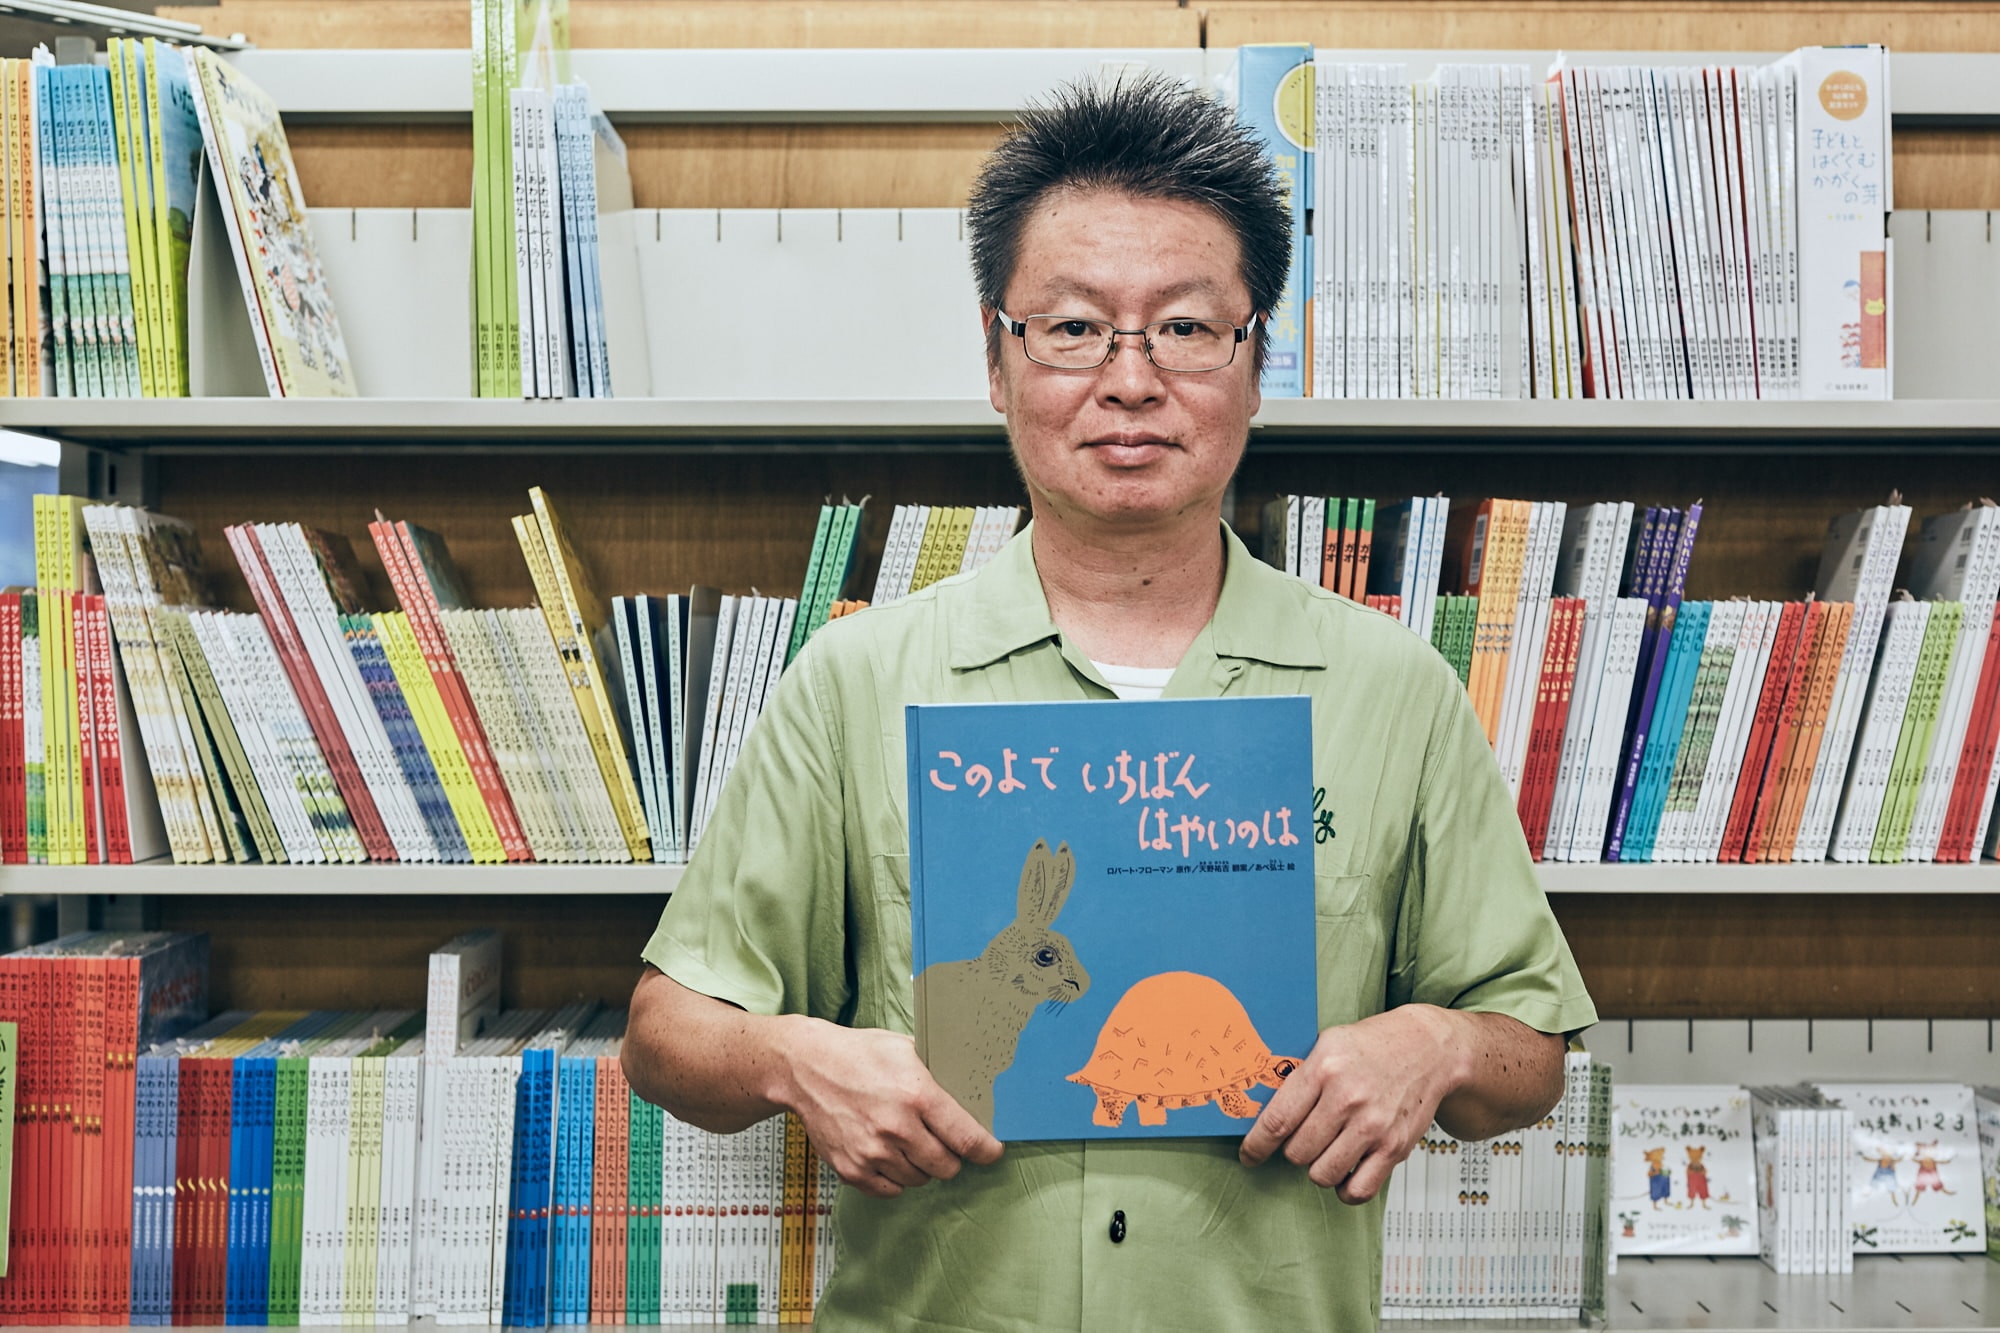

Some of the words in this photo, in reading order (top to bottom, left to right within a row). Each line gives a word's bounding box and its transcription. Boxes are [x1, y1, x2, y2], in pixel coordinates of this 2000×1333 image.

[1812, 129, 1864, 149] 子どもと
[1812, 152, 1875, 169] はぐくむ
[514, 162, 524, 217] しあわせな
[540, 163, 550, 218] しあわせな
[36, 510, 45, 580] サラダでげんき
[49, 510, 57, 580] サラダでげんき
[62, 511, 71, 580] サラダでげんき
[1406, 515, 1420, 578] おふろやさん
[1419, 516, 1434, 579] おふろやさん
[1431, 516, 1446, 579] おふろやさん
[1540, 517, 1560, 602] おなかのすくさんぽ
[1603, 518, 1629, 619] おっきょちゃんとかっぱ
[1632, 522, 1653, 593] おしいれじいさん
[1643, 522, 1666, 594] おしいれじいさん
[1654, 523, 1677, 594] おしいれじいさん
[1672, 520, 1697, 595] おしいれじいさん
[1969, 524, 2000, 631] あやちゃんのうまれたひ
[2, 605, 12, 720] サンタさんからきたてがみ
[11, 605, 22, 720] サンタさんからきたてがみ
[73, 609, 86, 679] さかさことばで
[640, 608, 652, 677] くじらのあかちゃん
[670, 608, 678, 676] くじらのあかちゃん
[1605, 612, 1624, 674] おじぞうさん
[1616, 611, 1634, 674] おじぞうさん
[1625, 612, 1644, 674] おじぞうさん
[1671, 611, 1685, 652] おかえし
[1682, 612, 1697, 653] おかえし
[1694, 610, 1709, 651] おかえし
[1773, 614, 1791, 661] エンソくん
[1800, 613, 1816, 661] エンソくん
[88, 611, 102, 679] さかさことばで
[95, 682, 108, 741] うんどうかい
[96, 609, 111, 679] さかさことばで
[104, 682, 118, 741] うんどうかい
[706, 610, 728, 731] くいしんぼうのあおむしくん
[721, 610, 747, 731] くいしんぼうのあおむしくん
[734, 610, 761, 732] くいしんぼうのあおむしくん
[1757, 666, 1777, 724] きしゃにのる
[1784, 666, 1803, 724] きしゃにのる
[1908, 613, 1939, 721] あらいぐまとねずみたち
[1920, 613, 1950, 721] あらいぐまとねずみたち
[1929, 613, 1959, 721] あらいぐまとねずみたち
[78, 681, 91, 741] うんどうかい
[930, 747, 1059, 797] このよで
[1082, 750, 1210, 805] いちばん
[1139, 806, 1299, 858] はやいのは
[1107, 865, 1174, 875] ロバート・フローマン
[129, 973, 137, 1010] おおさむ
[107, 1016, 115, 1044] こさむ
[127, 1016, 135, 1044] こさむ
[146, 1071, 155, 1137] ふわふわふとん
[156, 1071, 165, 1137] ふわふわふとん
[168, 1071, 177, 1137] ふわふわふとん
[201, 1070, 210, 1137] きんいろあらし
[211, 1070, 220, 1137] きんいろあらし
[221, 1070, 231, 1137] きんいろあらし
[309, 1070, 317, 1136] まほうのえのぐ
[340, 1070, 349, 1136] まほうのえのぐ
[349, 1070, 360, 1156] はじめてのおつかい
[360, 1070, 371, 1156] はじめてのおつかい
[371, 1070, 382, 1156] はじめてのおつかい
[557, 1069, 568, 1197] だるまちゃんとキジムナちゃん
[581, 1069, 592, 1198] だるまちゃんとキジムナちゃん
[594, 1068, 607, 1199] だるまちゃんとかまどんちゃん
[1569, 1066, 1578, 1135] あひるのたまご
[1579, 1065, 1588, 1134] あひるのたまご
[569, 1070, 581, 1198] だるまちゃんとキジムナちゃん
[605, 1069, 618, 1199] だるまちゃんとかまどんちゃん
